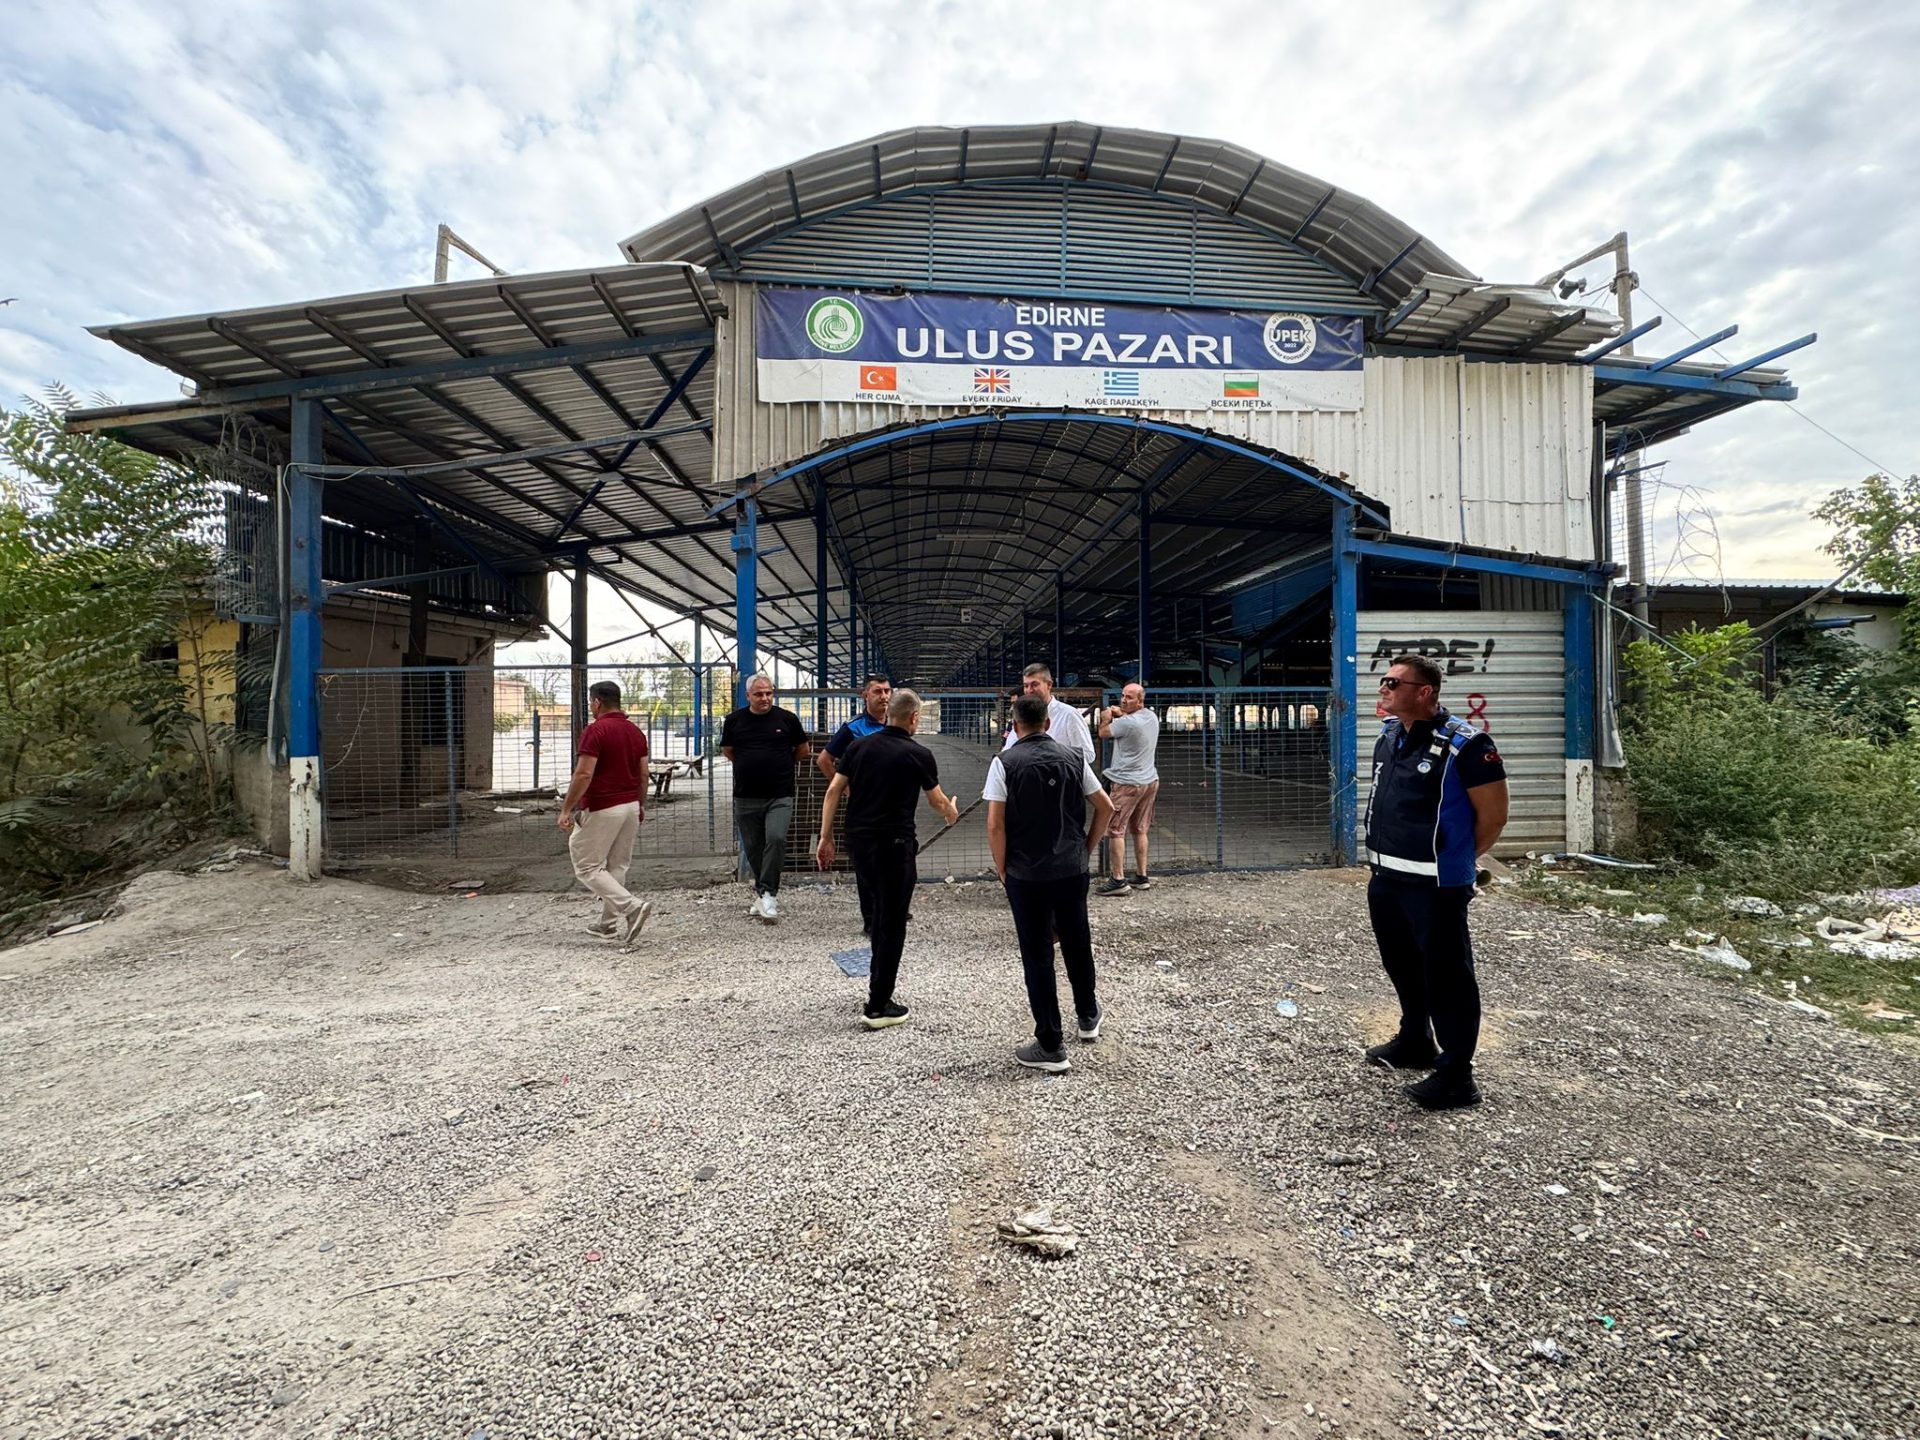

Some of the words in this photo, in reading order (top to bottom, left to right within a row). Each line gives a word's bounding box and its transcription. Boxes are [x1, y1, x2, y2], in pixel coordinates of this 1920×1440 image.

[1016, 302, 1105, 327] EDİRNE
[1269, 328, 1312, 344] UPEK
[896, 327, 1035, 361] ULUS
[1052, 332, 1233, 365] PAZARI
[855, 392, 874, 400] HER
[875, 393, 900, 401] CUMA
[962, 395, 991, 403] EVERY
[992, 395, 1022, 404] FRIDAY
[1211, 399, 1240, 408] ВСЕКИ
[1242, 399, 1272, 408] ПЕТЪК
